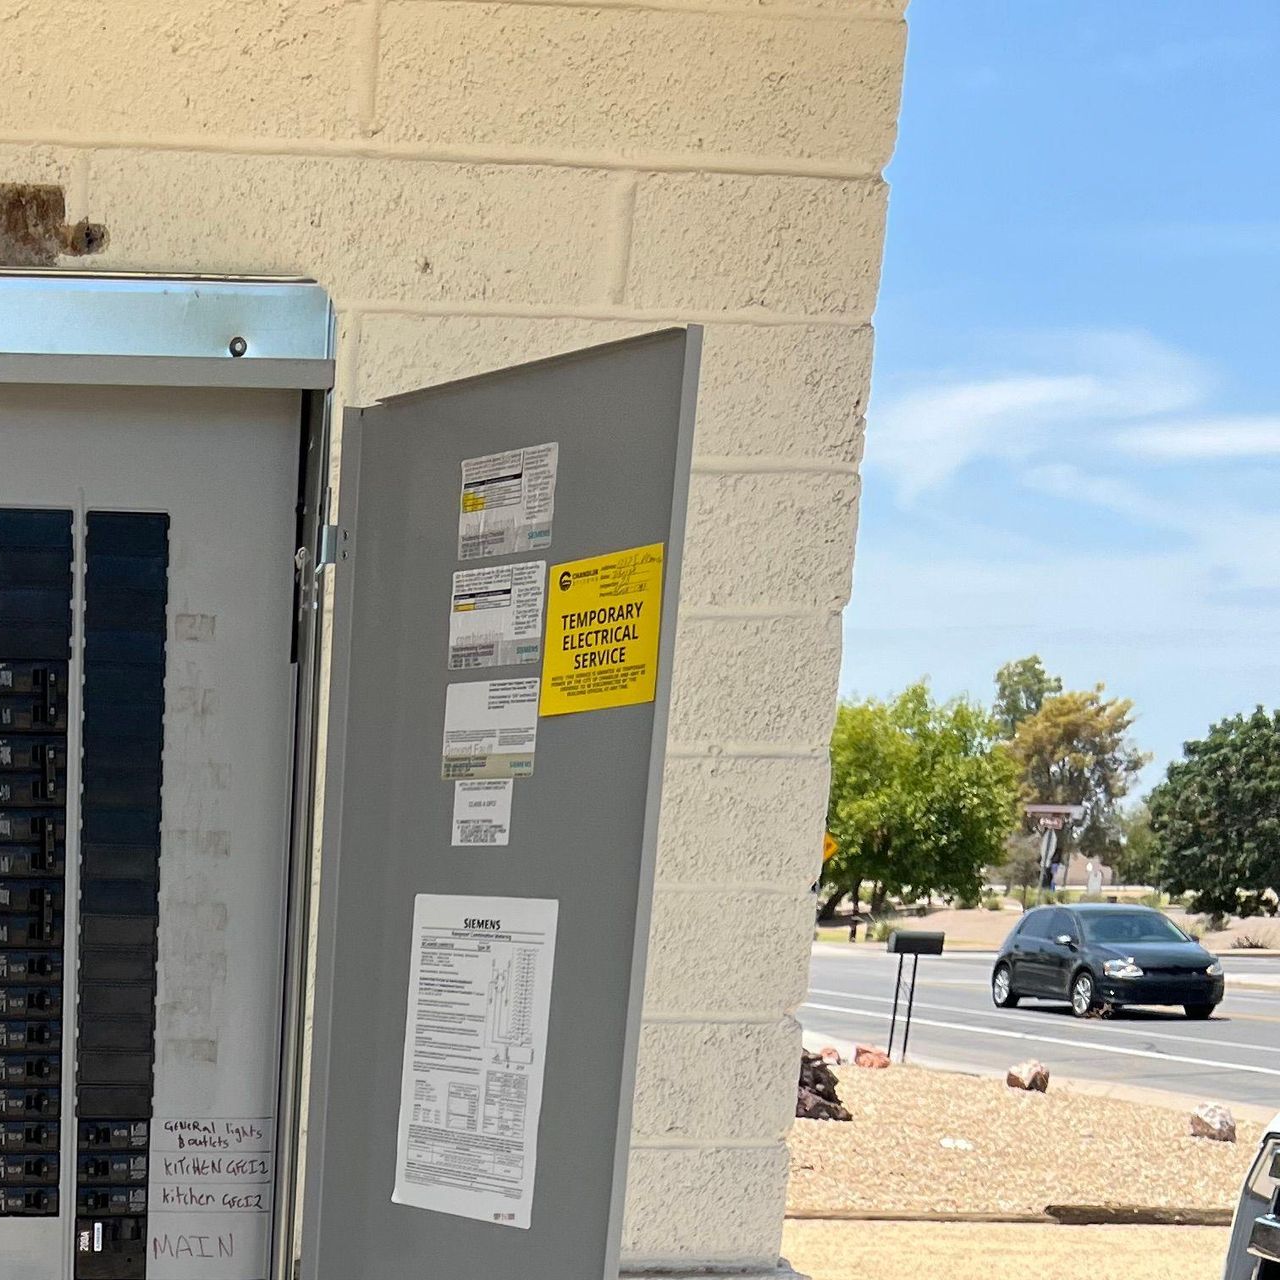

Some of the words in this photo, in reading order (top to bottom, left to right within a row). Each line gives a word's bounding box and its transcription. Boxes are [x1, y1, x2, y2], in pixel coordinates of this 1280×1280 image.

[561, 601, 644, 631] TEMPORARY
[562, 624, 639, 651] ELECTRICAL
[574, 647, 626, 670] SERVICE
[464, 918, 501, 930] SIEMENS
[226, 1122, 262, 1142] lights
[153, 1233, 234, 1260] MAIN
